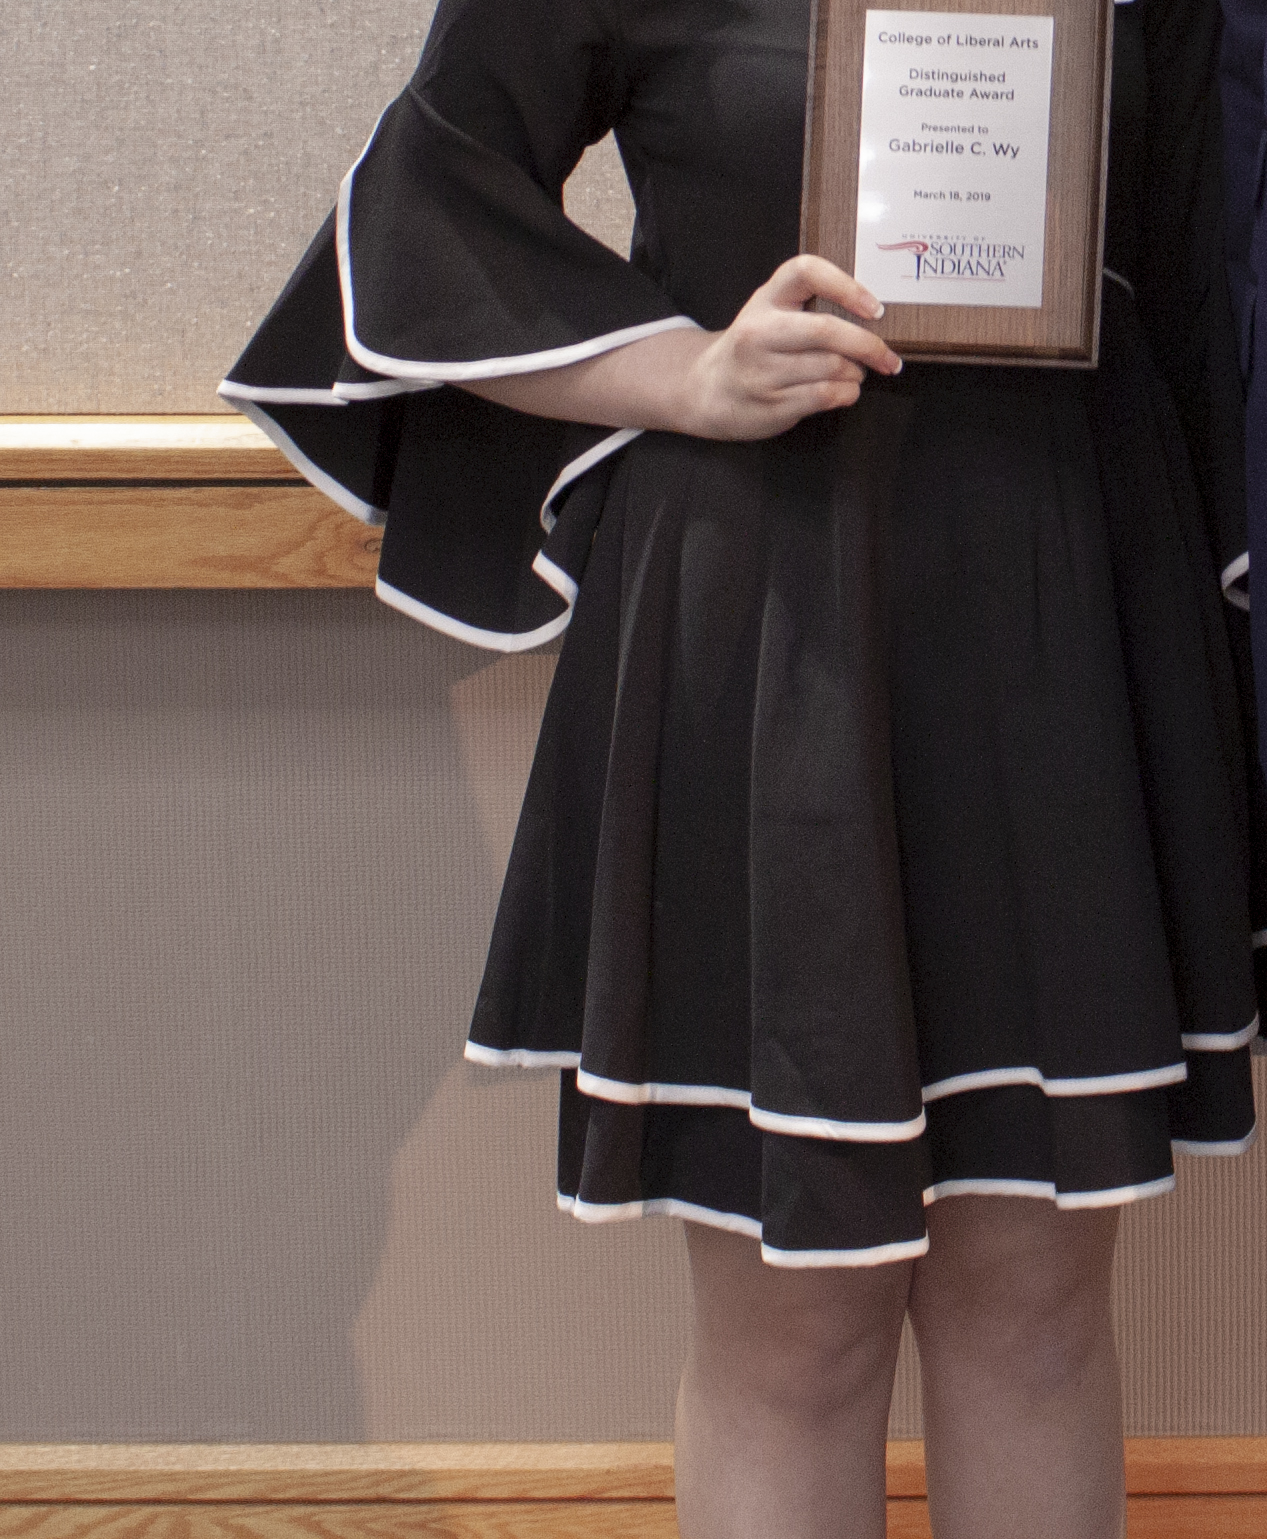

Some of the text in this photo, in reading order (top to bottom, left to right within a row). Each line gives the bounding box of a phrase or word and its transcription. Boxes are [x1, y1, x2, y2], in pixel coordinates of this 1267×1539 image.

[878, 31, 1039, 49] College of Liberal Arts
[909, 68, 1006, 83] Distinguished
[899, 86, 1015, 102] Graduate Award
[921, 123, 989, 134] Presented to
[889, 138, 1020, 159] Gabrielle C. Wy
[914, 190, 991, 203] March 18, 2019
[930, 241, 1025, 259] SOUTHERN
